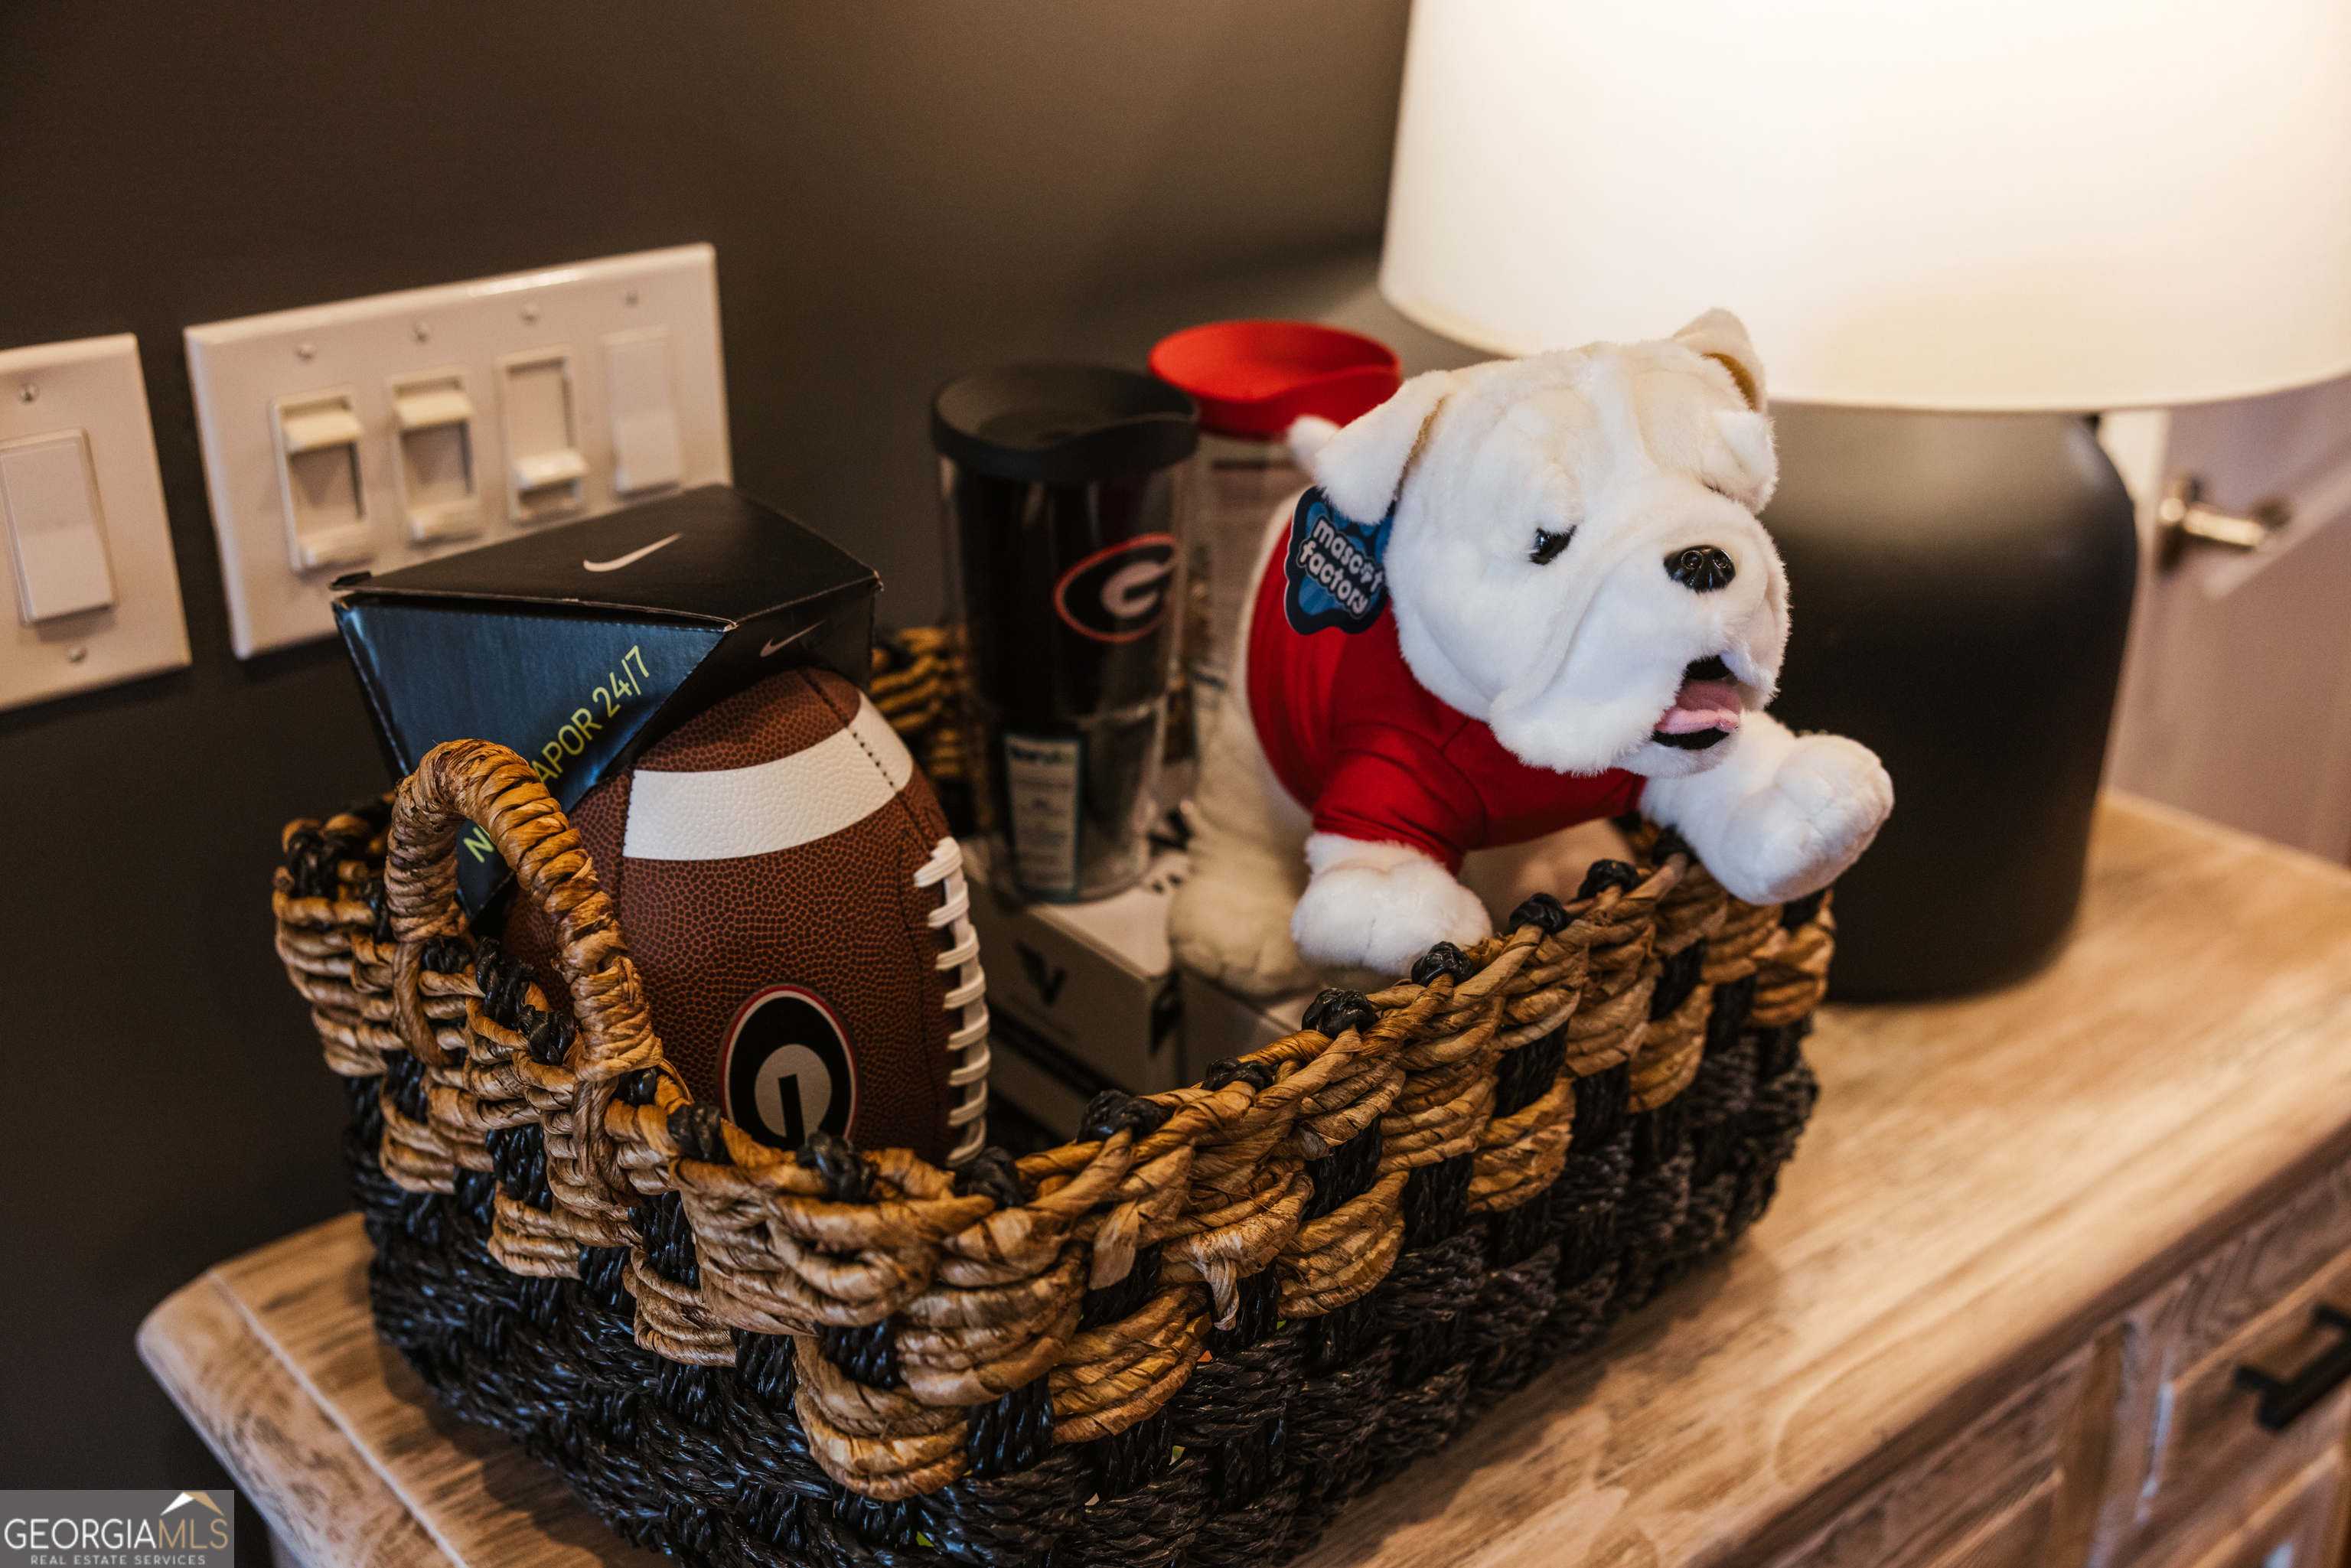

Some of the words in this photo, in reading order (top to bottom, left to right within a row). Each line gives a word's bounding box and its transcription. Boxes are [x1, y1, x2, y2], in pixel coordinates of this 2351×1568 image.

[1299, 540, 1368, 614] factory
[531, 708, 603, 788] APOR
[592, 645, 650, 719] 24/7
